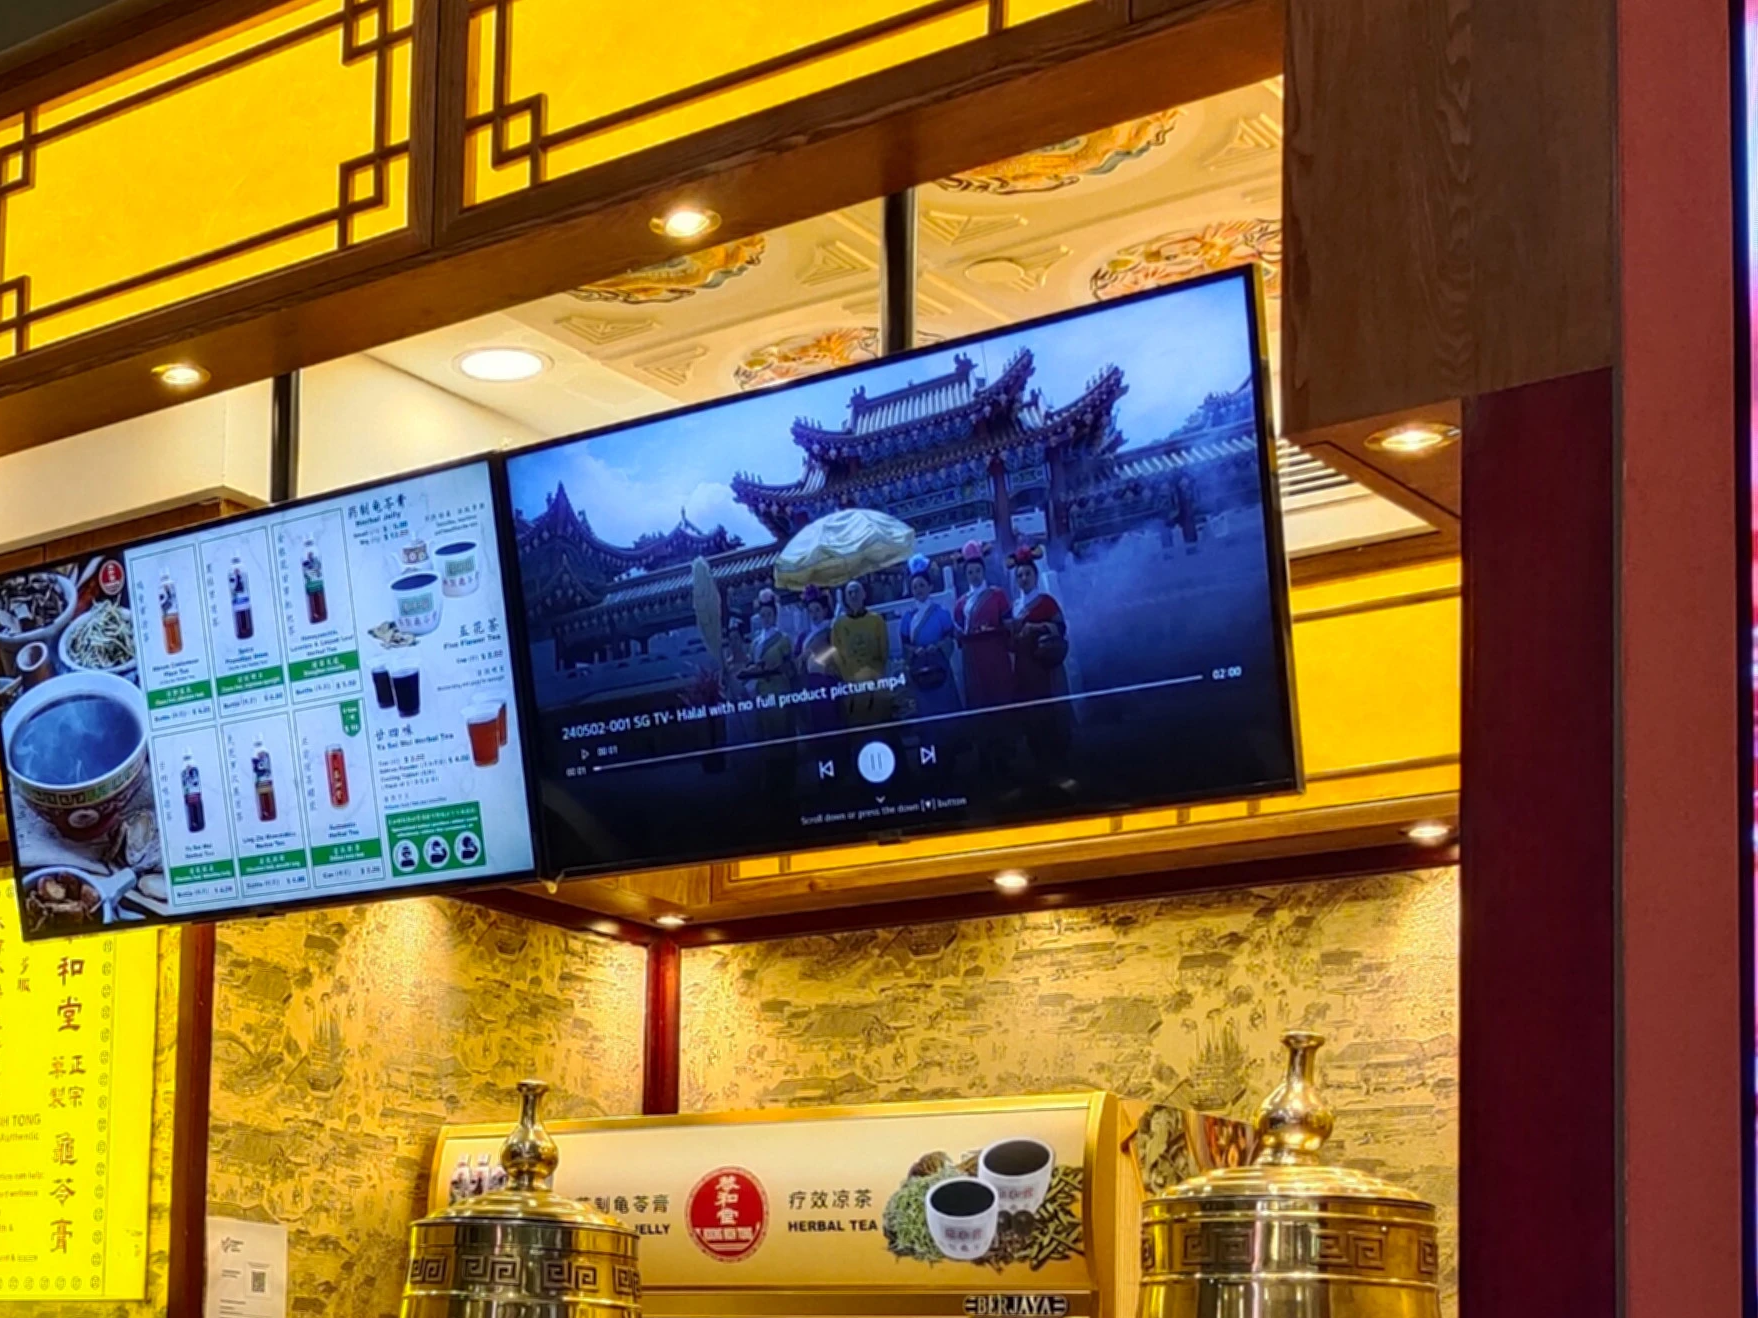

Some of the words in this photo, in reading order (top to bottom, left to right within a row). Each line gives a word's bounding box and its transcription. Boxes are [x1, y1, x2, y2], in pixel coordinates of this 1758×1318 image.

[1211, 664, 1243, 681] 02:00
[562, 717, 632, 741] 240502-001
[633, 714, 651, 730] SG
[676, 704, 707, 722] Halal
[709, 700, 735, 717] with
[737, 699, 754, 714] no
[755, 692, 776, 710] full
[778, 685, 827, 709] product
[829, 672, 907, 701] picture.mp4
[801, 811, 823, 826] Scroll
[824, 809, 846, 823] down
[848, 810, 856, 820] or
[858, 806, 880, 820] press
[897, 802, 920, 813] down
[57, 938, 85, 1032] 和堂
[12, 1113, 41, 1126] TONG
[788, 1188, 873, 1211] 疗效凉茶
[788, 1219, 844, 1233] HERBAL
[850, 1218, 879, 1232] TEA
[976, 1294, 1053, 1316] BERJAYA
